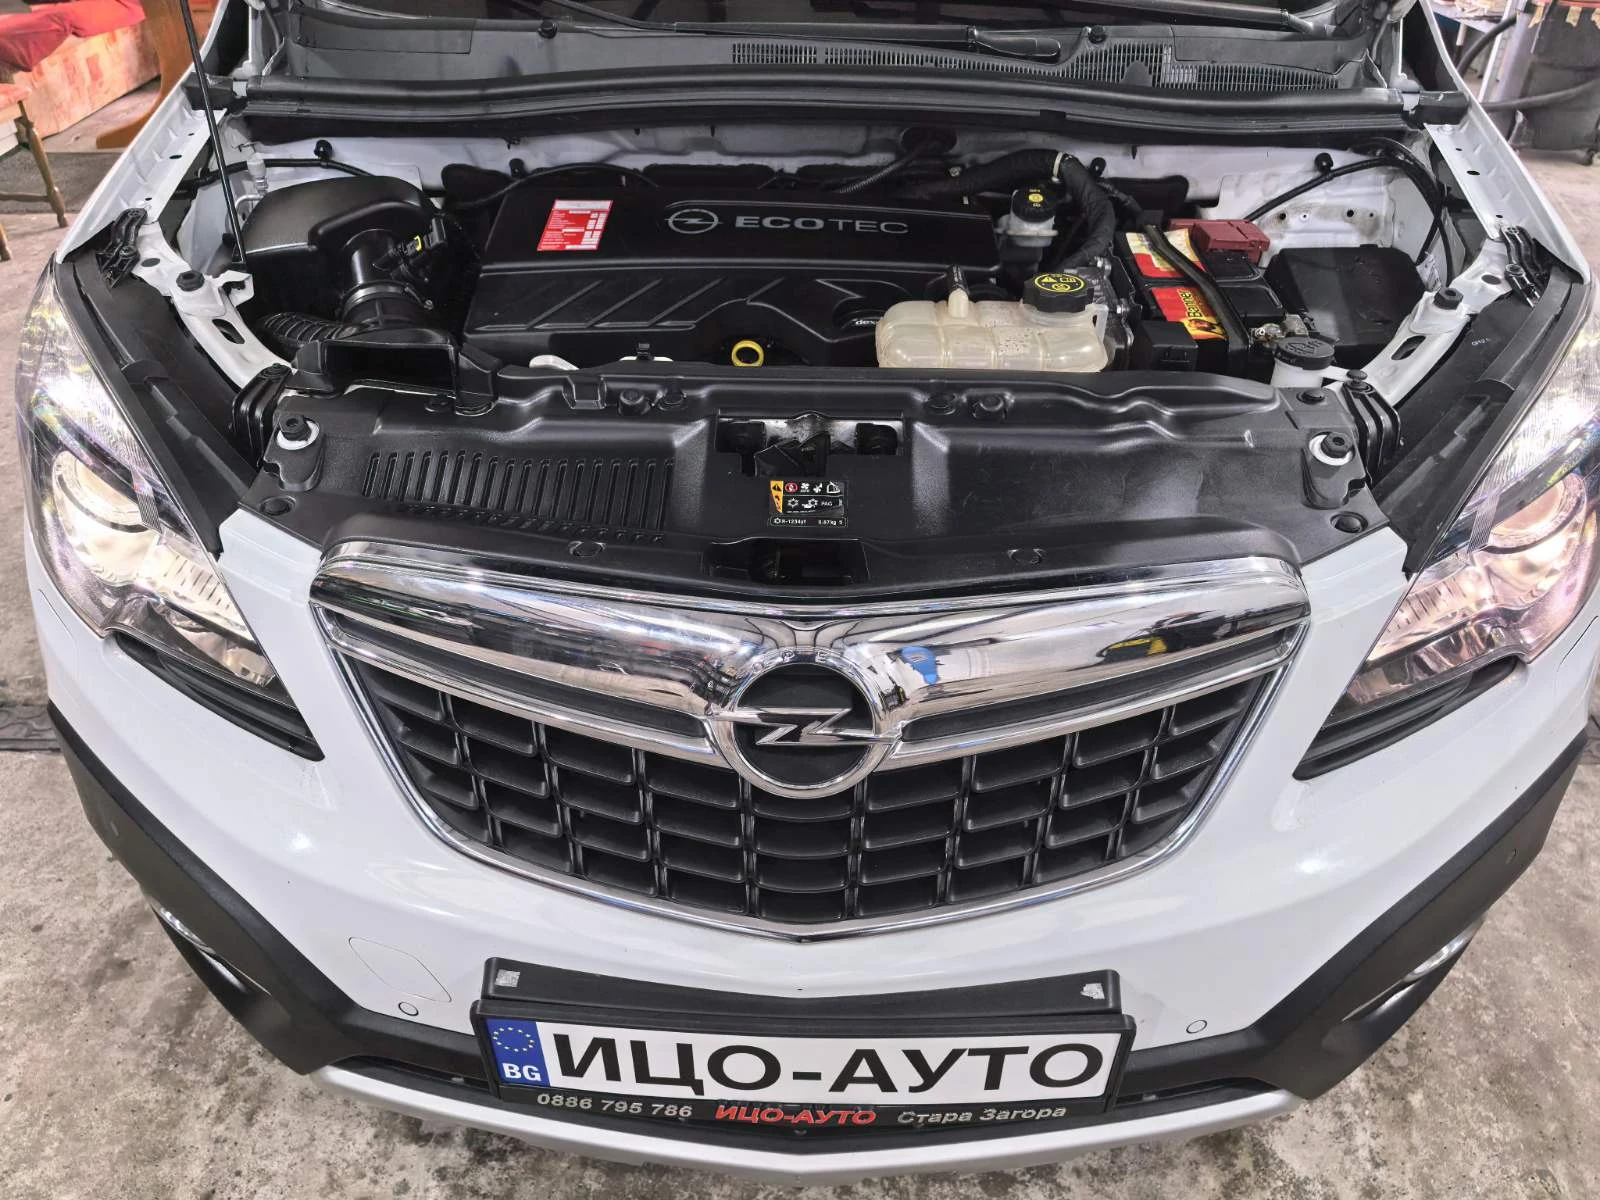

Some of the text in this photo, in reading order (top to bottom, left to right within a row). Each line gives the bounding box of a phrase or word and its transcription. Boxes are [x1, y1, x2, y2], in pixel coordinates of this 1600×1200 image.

[735, 215, 909, 234] ECOTEC
[1179, 290, 1203, 318] Banner
[501, 1062, 542, 1082] BG
[552, 1033, 1104, 1096] ИЦО-АУТО
[536, 1093, 693, 1118] 0886 795 786
[715, 1104, 877, 1126] ИЦО-АУТО
[897, 1106, 1067, 1125] Стара Загора
